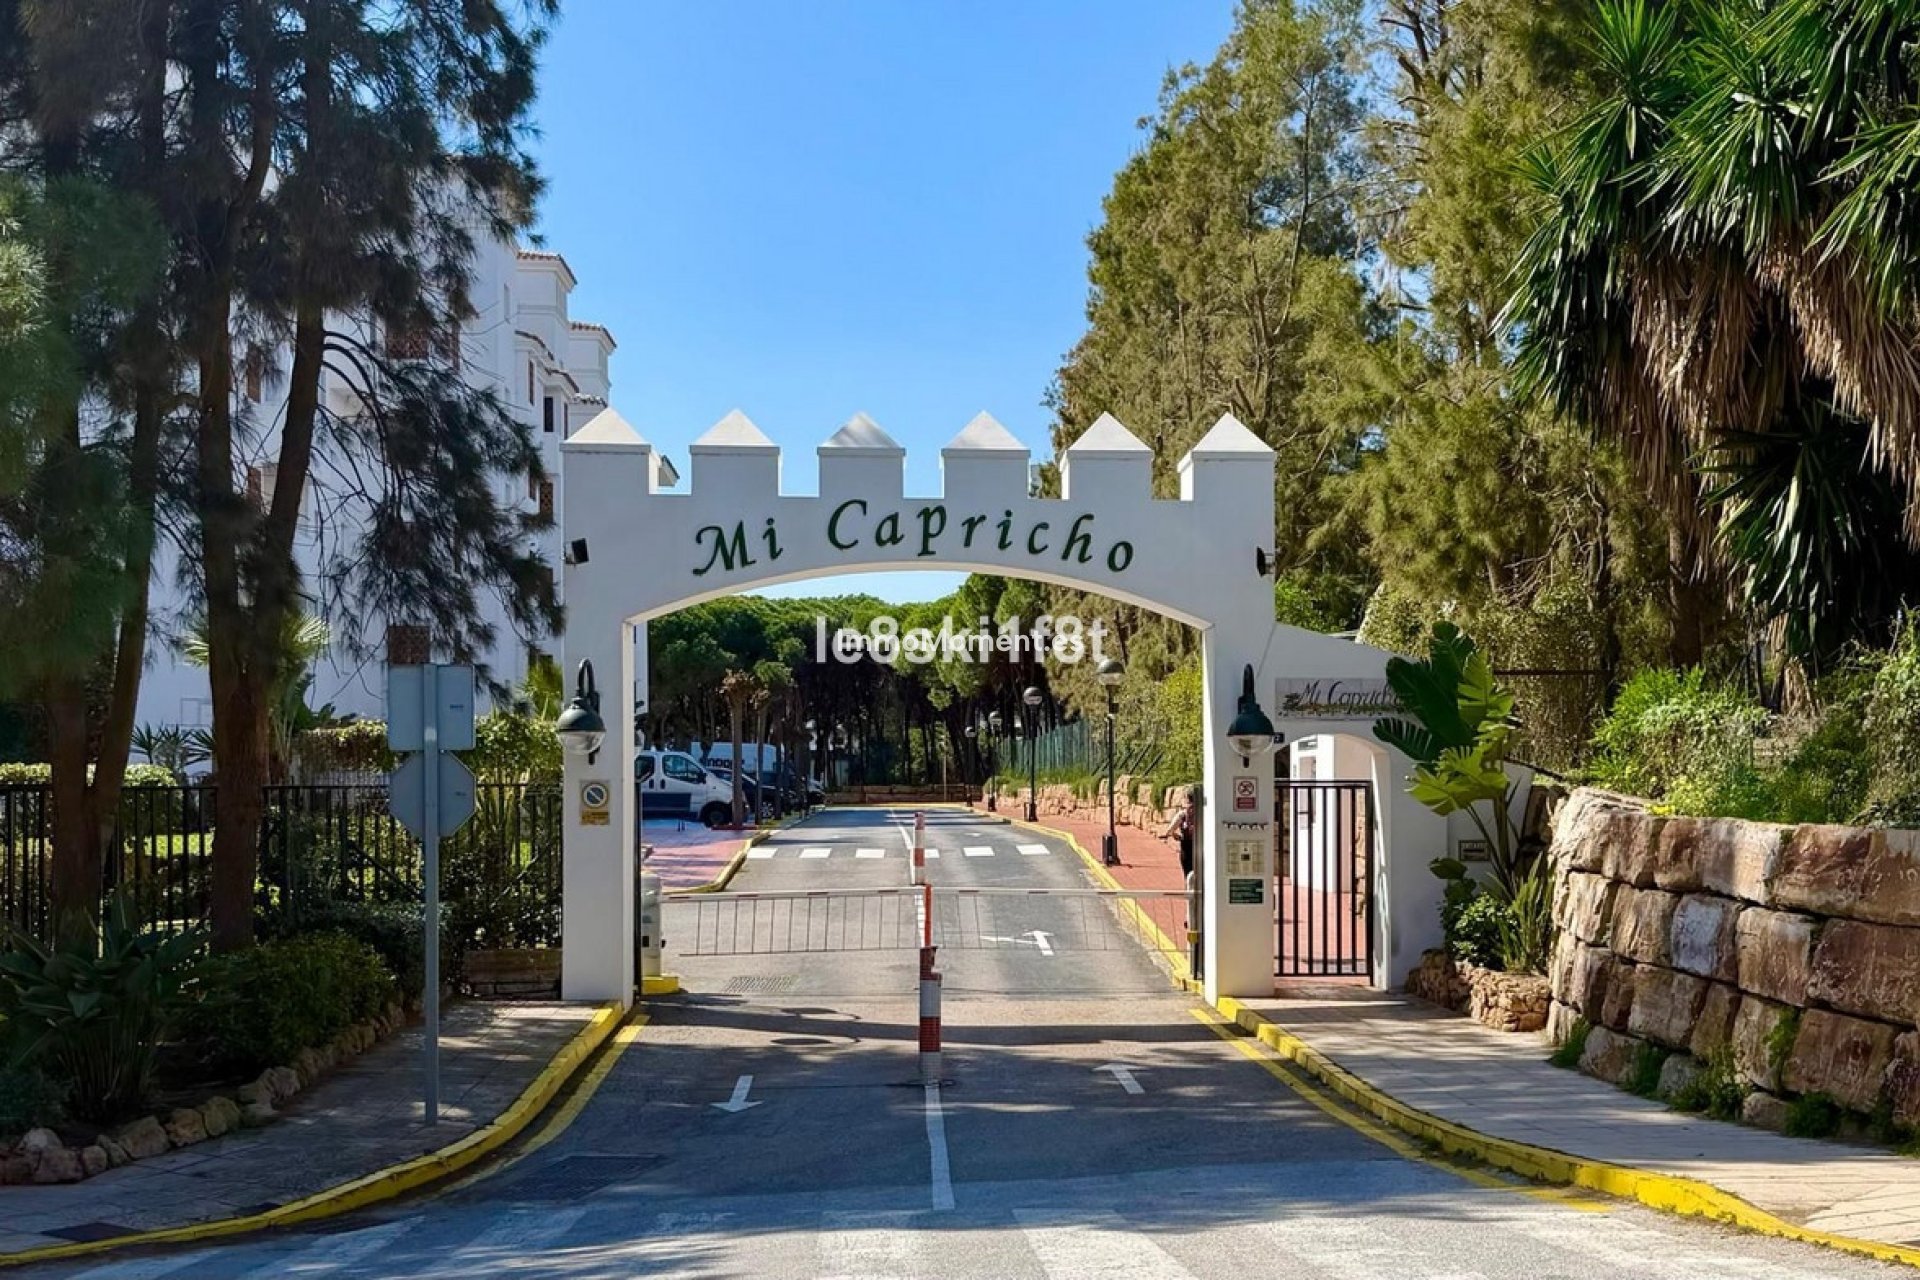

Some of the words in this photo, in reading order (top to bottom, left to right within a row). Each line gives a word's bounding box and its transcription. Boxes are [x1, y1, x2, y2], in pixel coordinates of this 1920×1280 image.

[692, 517, 784, 577] Mi
[827, 499, 1134, 573] Capricho
[1297, 679, 1322, 706] Mi
